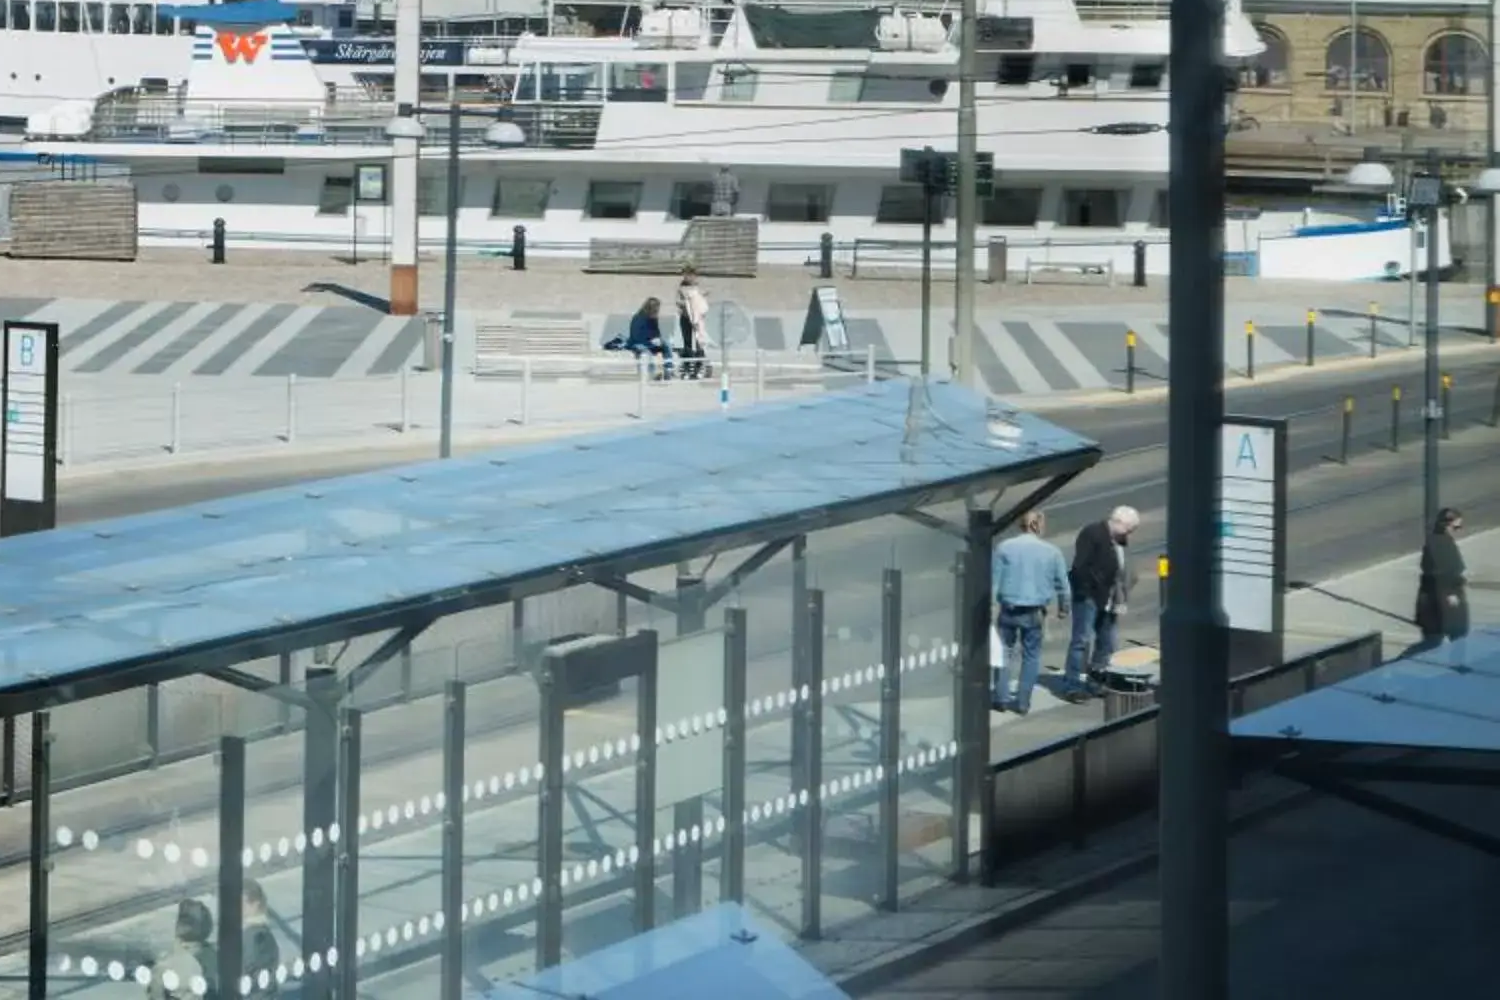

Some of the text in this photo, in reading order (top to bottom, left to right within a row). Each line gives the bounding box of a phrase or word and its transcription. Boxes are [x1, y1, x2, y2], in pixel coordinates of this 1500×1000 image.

[216, 31, 268, 64] W
[21, 335, 34, 366] B
[1235, 433, 1257, 469] A
